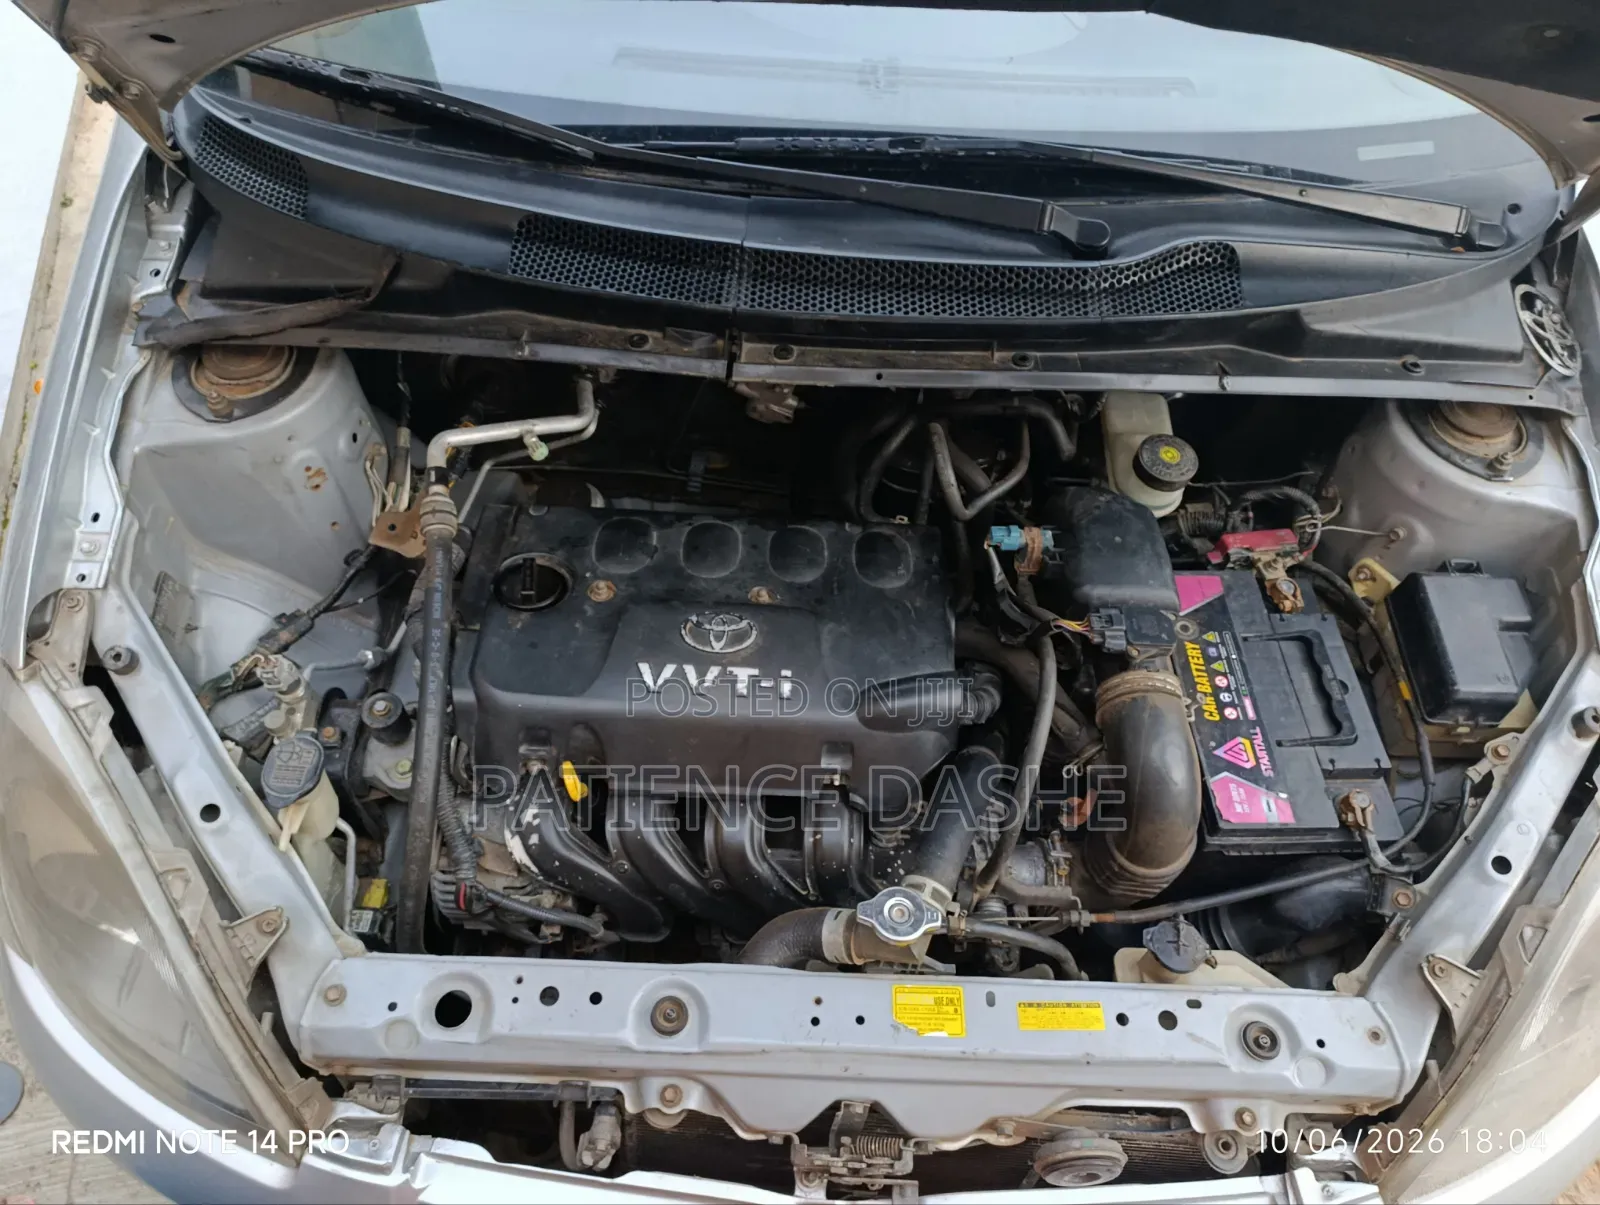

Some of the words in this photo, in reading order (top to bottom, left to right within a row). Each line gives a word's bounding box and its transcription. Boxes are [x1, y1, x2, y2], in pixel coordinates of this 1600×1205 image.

[636, 661, 793, 700] VVT-i
[1184, 641, 1212, 693] BATTERY
[945, 996, 960, 1007] ONLY
